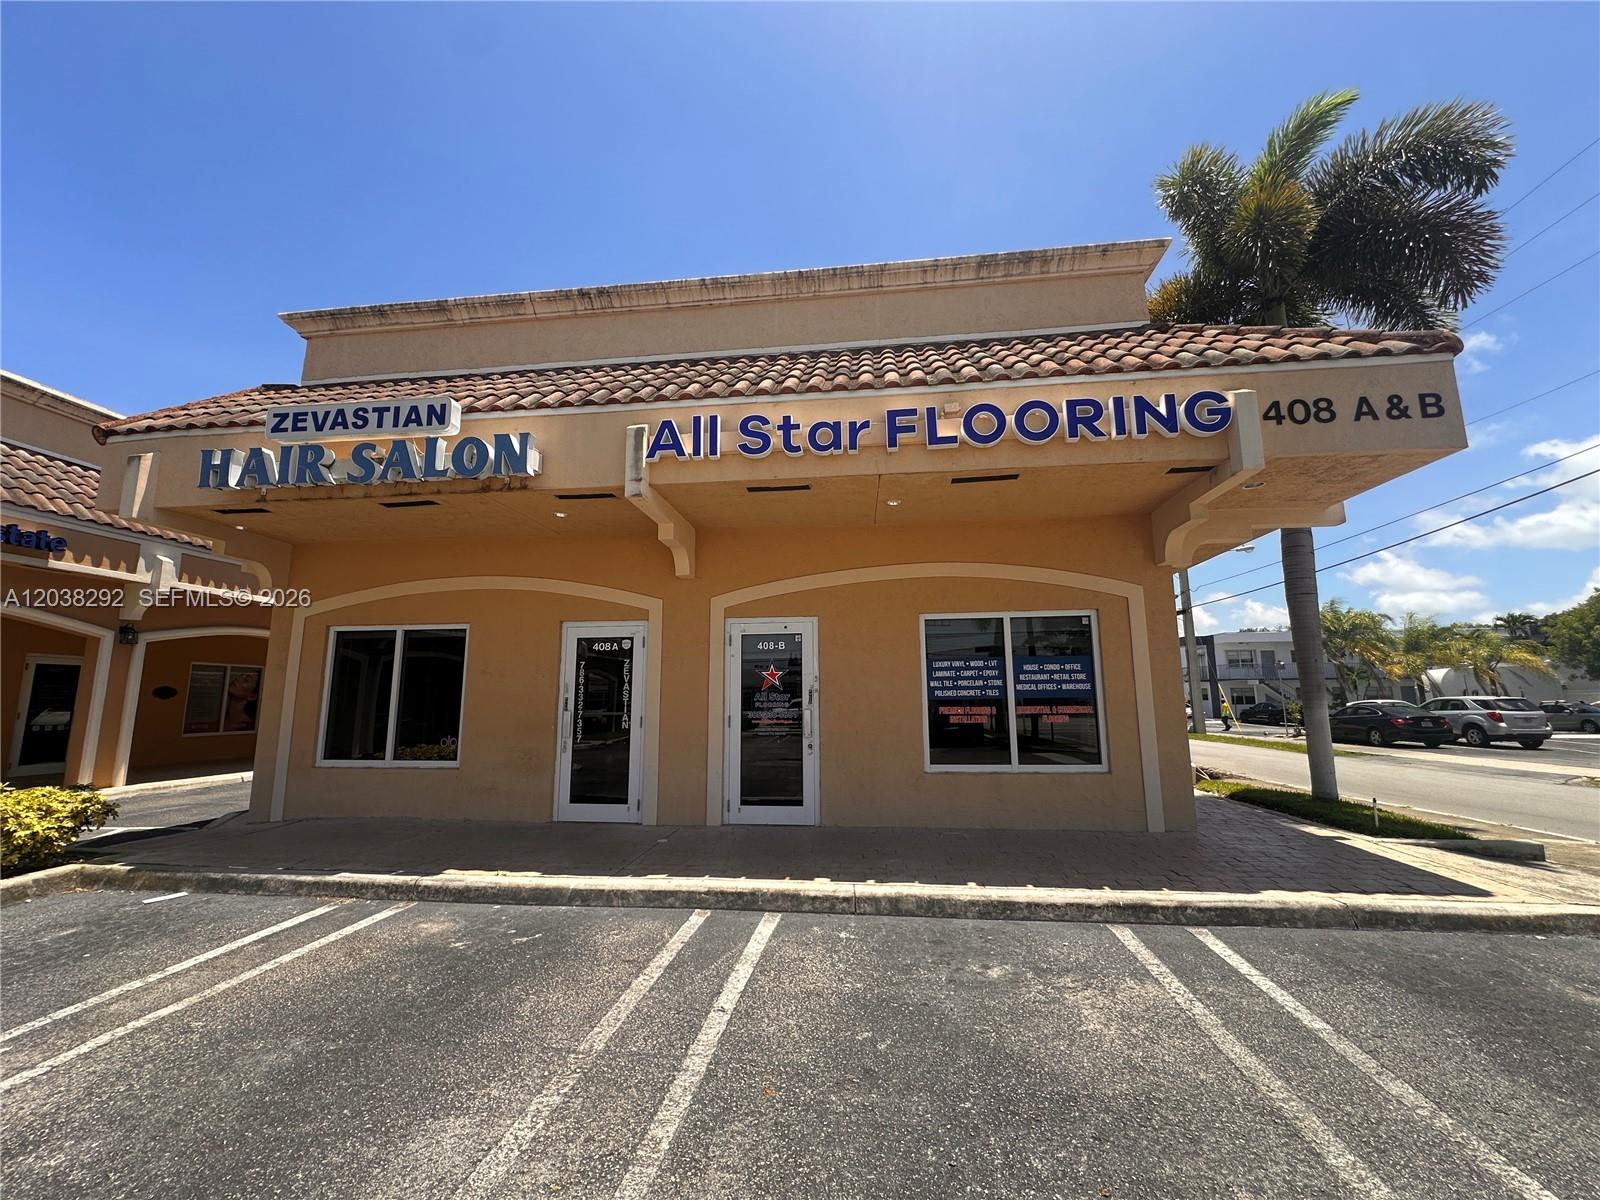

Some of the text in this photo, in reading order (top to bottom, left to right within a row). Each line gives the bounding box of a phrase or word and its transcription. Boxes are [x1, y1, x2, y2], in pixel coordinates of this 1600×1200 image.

[270, 402, 447, 433] ZEVASTIAN
[646, 389, 1232, 462] All Star FLOORING
[1263, 397, 1336, 426] 408
[196, 432, 537, 489] HAIR SALON
[757, 641, 785, 650] 408-B
[621, 658, 631, 730] ZEVASTIAN
